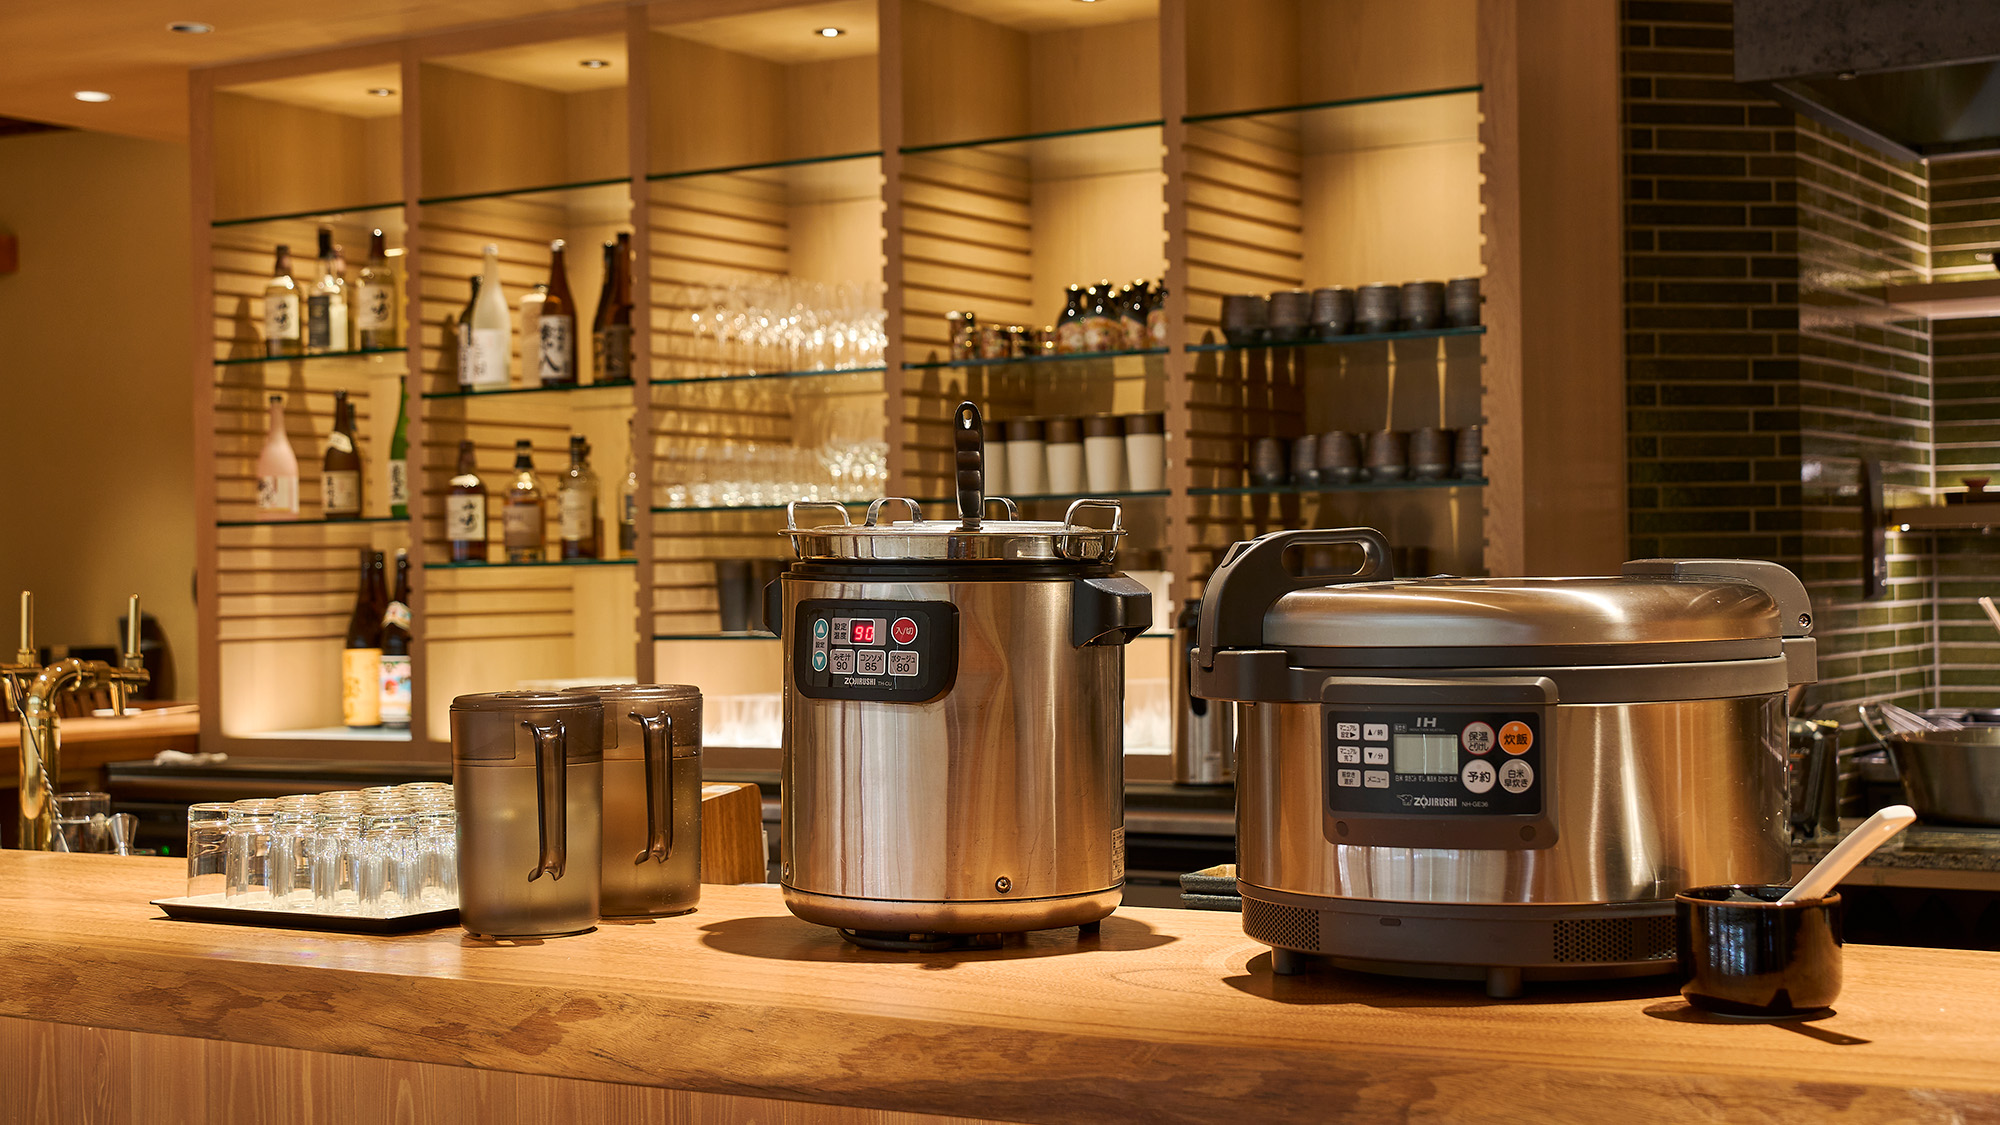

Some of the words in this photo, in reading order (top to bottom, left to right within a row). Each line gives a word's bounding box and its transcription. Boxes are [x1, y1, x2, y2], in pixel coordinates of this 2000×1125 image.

[834, 623, 847, 631] 設定
[896, 627, 914, 636] 入/切
[854, 626, 874, 641] 90
[860, 654, 883, 662] コンソメ
[836, 661, 848, 671] 90
[864, 662, 878, 671] 85
[896, 663, 910, 673] 80
[844, 677, 876, 686] ZOJIRUSHI
[1416, 717, 1437, 728] IH
[1468, 731, 1489, 741] 保温
[1503, 733, 1528, 745] 炊飯
[1468, 742, 1489, 751] とりけし
[1367, 775, 1387, 783] メニュー
[1467, 771, 1491, 783] 予約
[1508, 769, 1525, 779] 白米
[1504, 778, 1529, 788] 早炊き
[1413, 796, 1457, 807] ZOJIRUSHI
